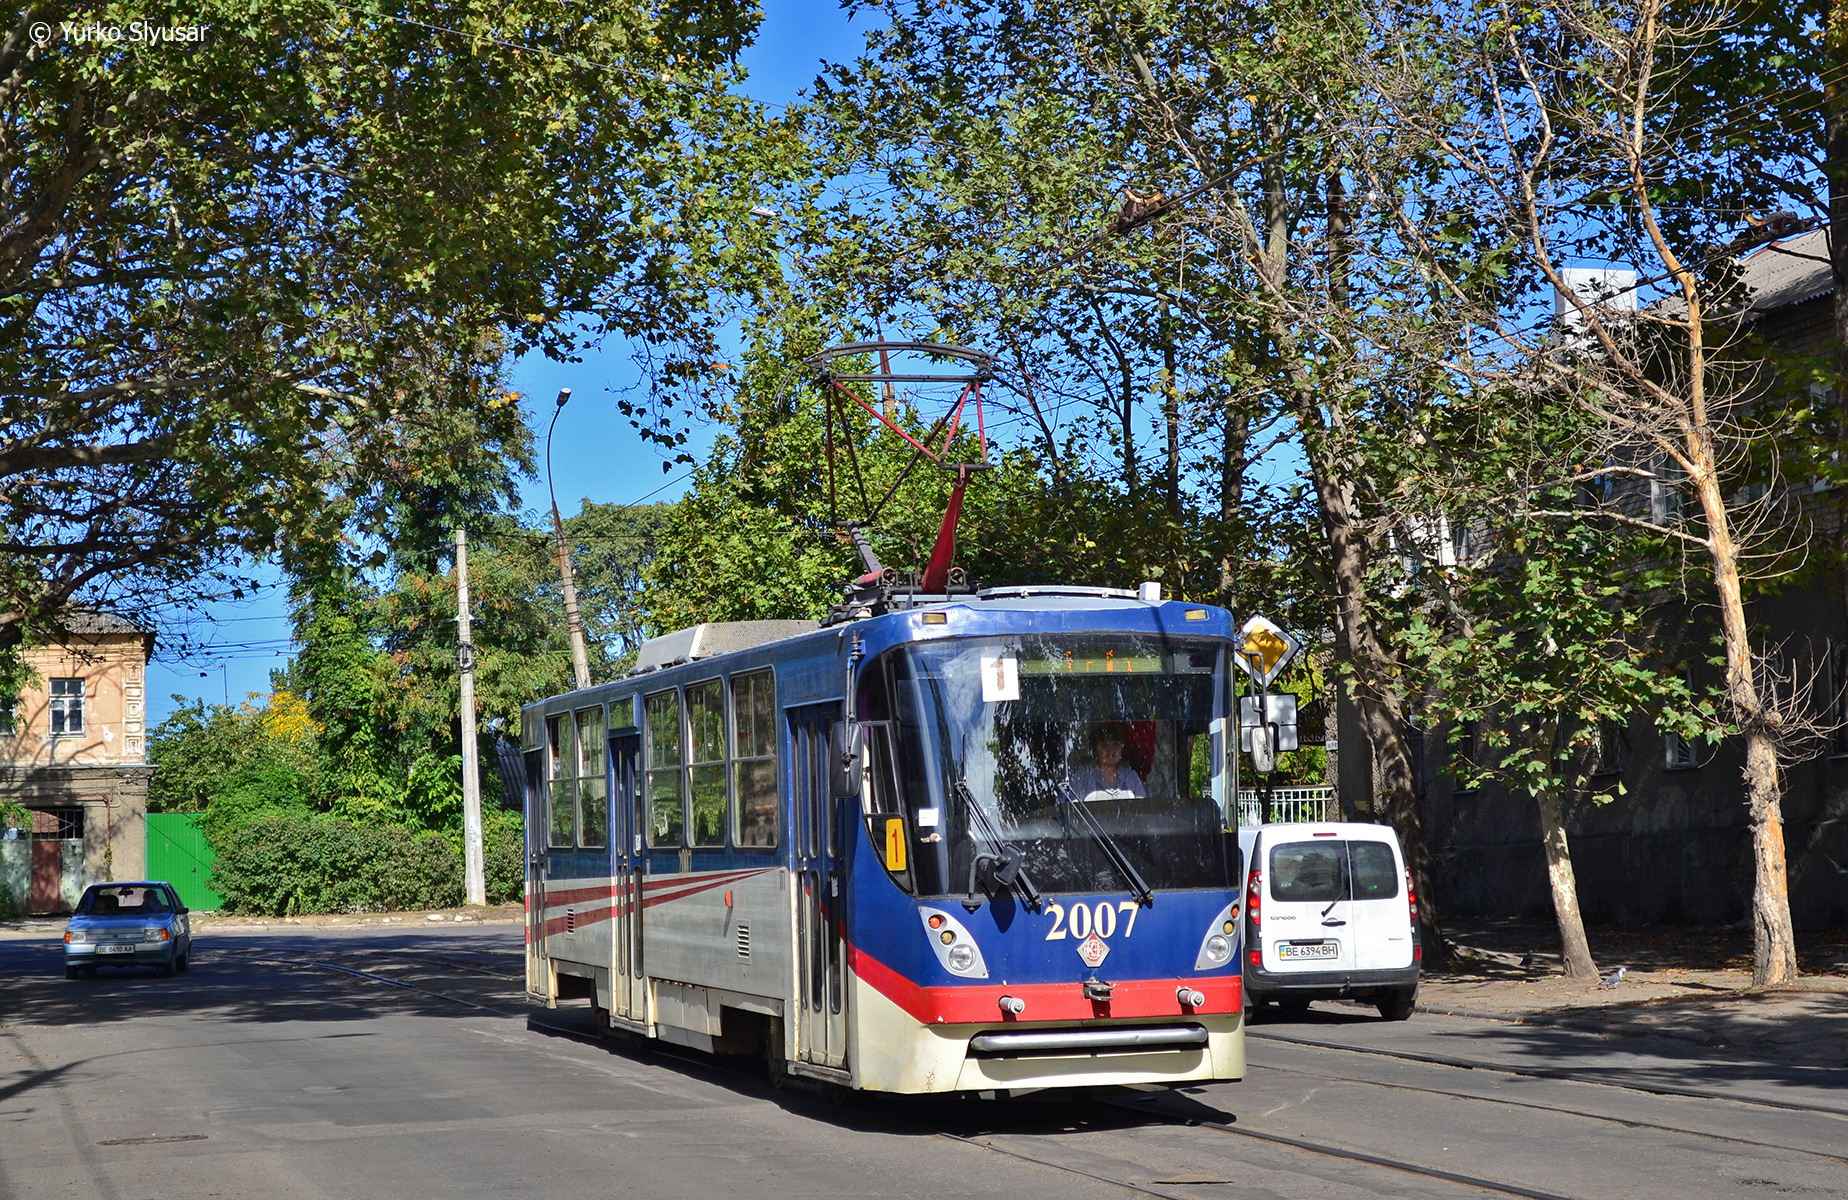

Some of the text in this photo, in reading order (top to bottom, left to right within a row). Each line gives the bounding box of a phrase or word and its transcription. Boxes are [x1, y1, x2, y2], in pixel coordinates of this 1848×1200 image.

[990, 656, 1005, 690] 1
[892, 828, 899, 863] 1
[1044, 901, 1139, 941] 2007
[1285, 946, 1335, 956] BE 6394 BH
